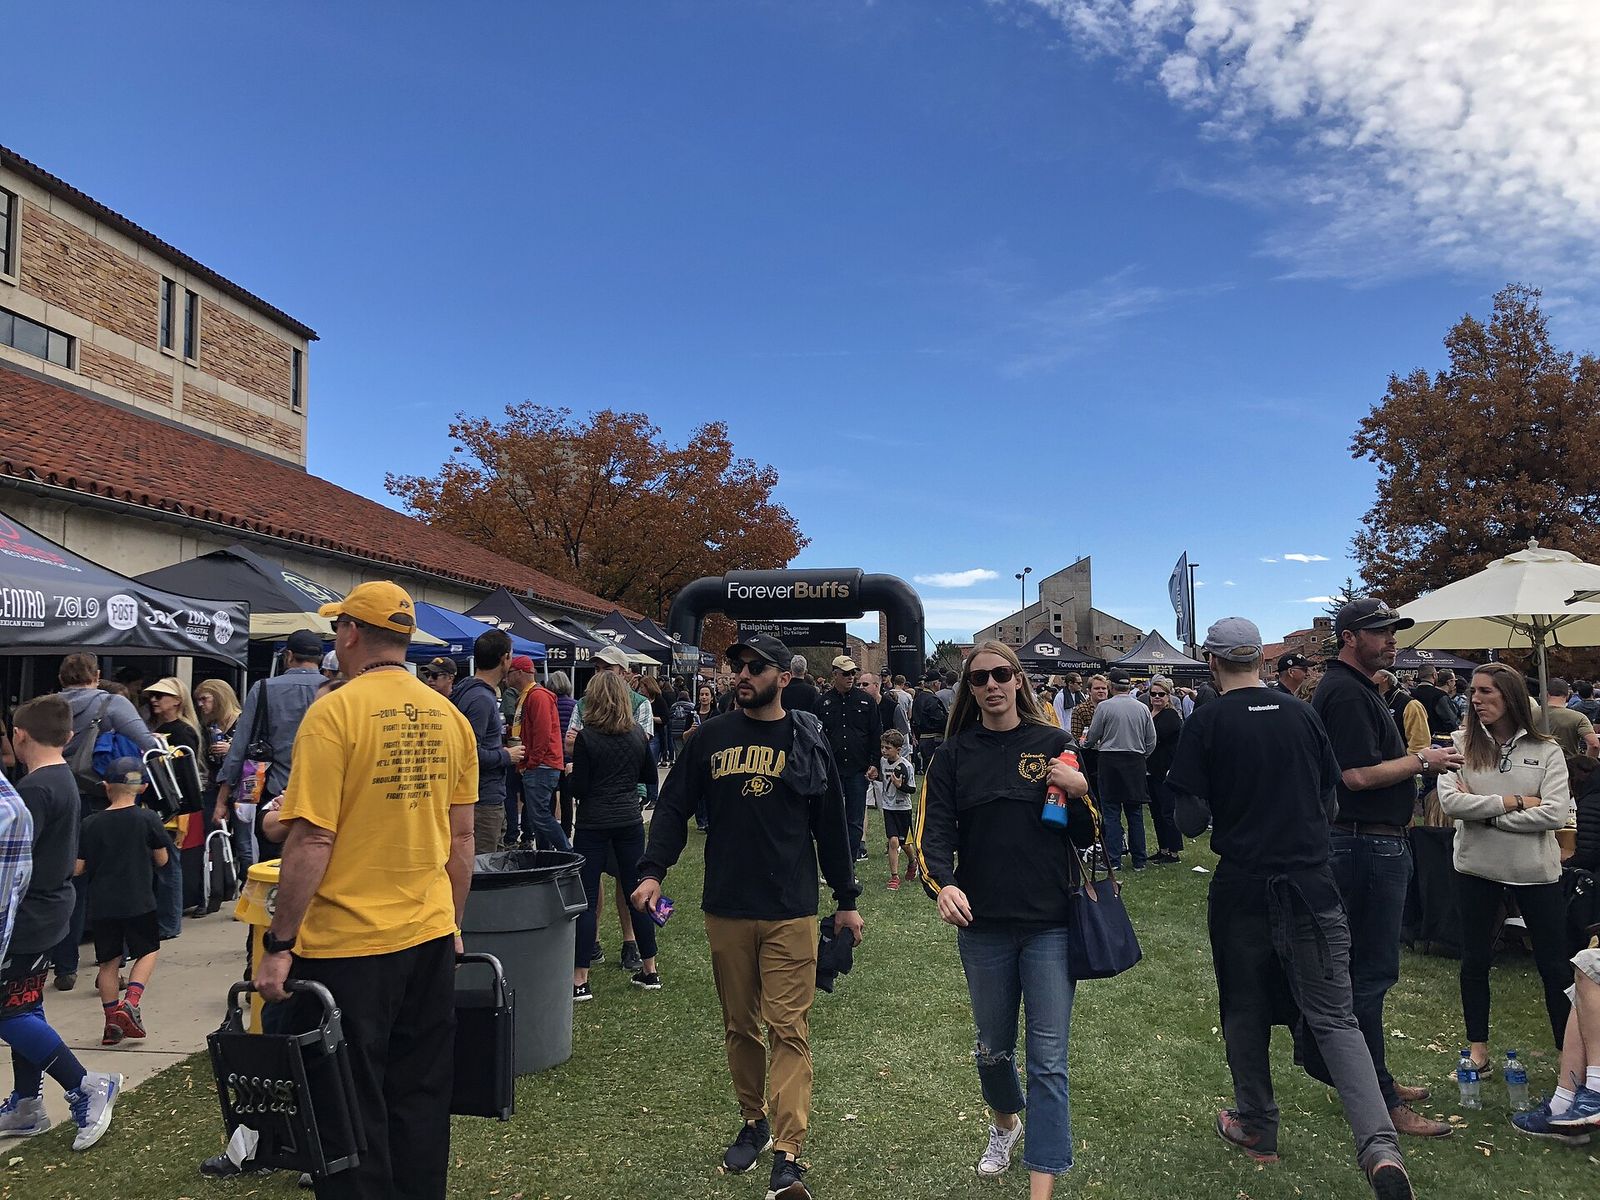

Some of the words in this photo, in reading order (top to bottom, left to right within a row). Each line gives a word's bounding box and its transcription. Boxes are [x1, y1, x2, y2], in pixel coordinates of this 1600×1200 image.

[727, 582, 850, 599] ForeverBuffs
[53, 595, 100, 619] ZOLO
[111, 603, 135, 621] POST
[740, 623, 780, 632] Ralphie's
[1057, 660, 1101, 669] ForeverBuffs
[1148, 665, 1173, 675] NEXT
[711, 745, 786, 780] COLORA
